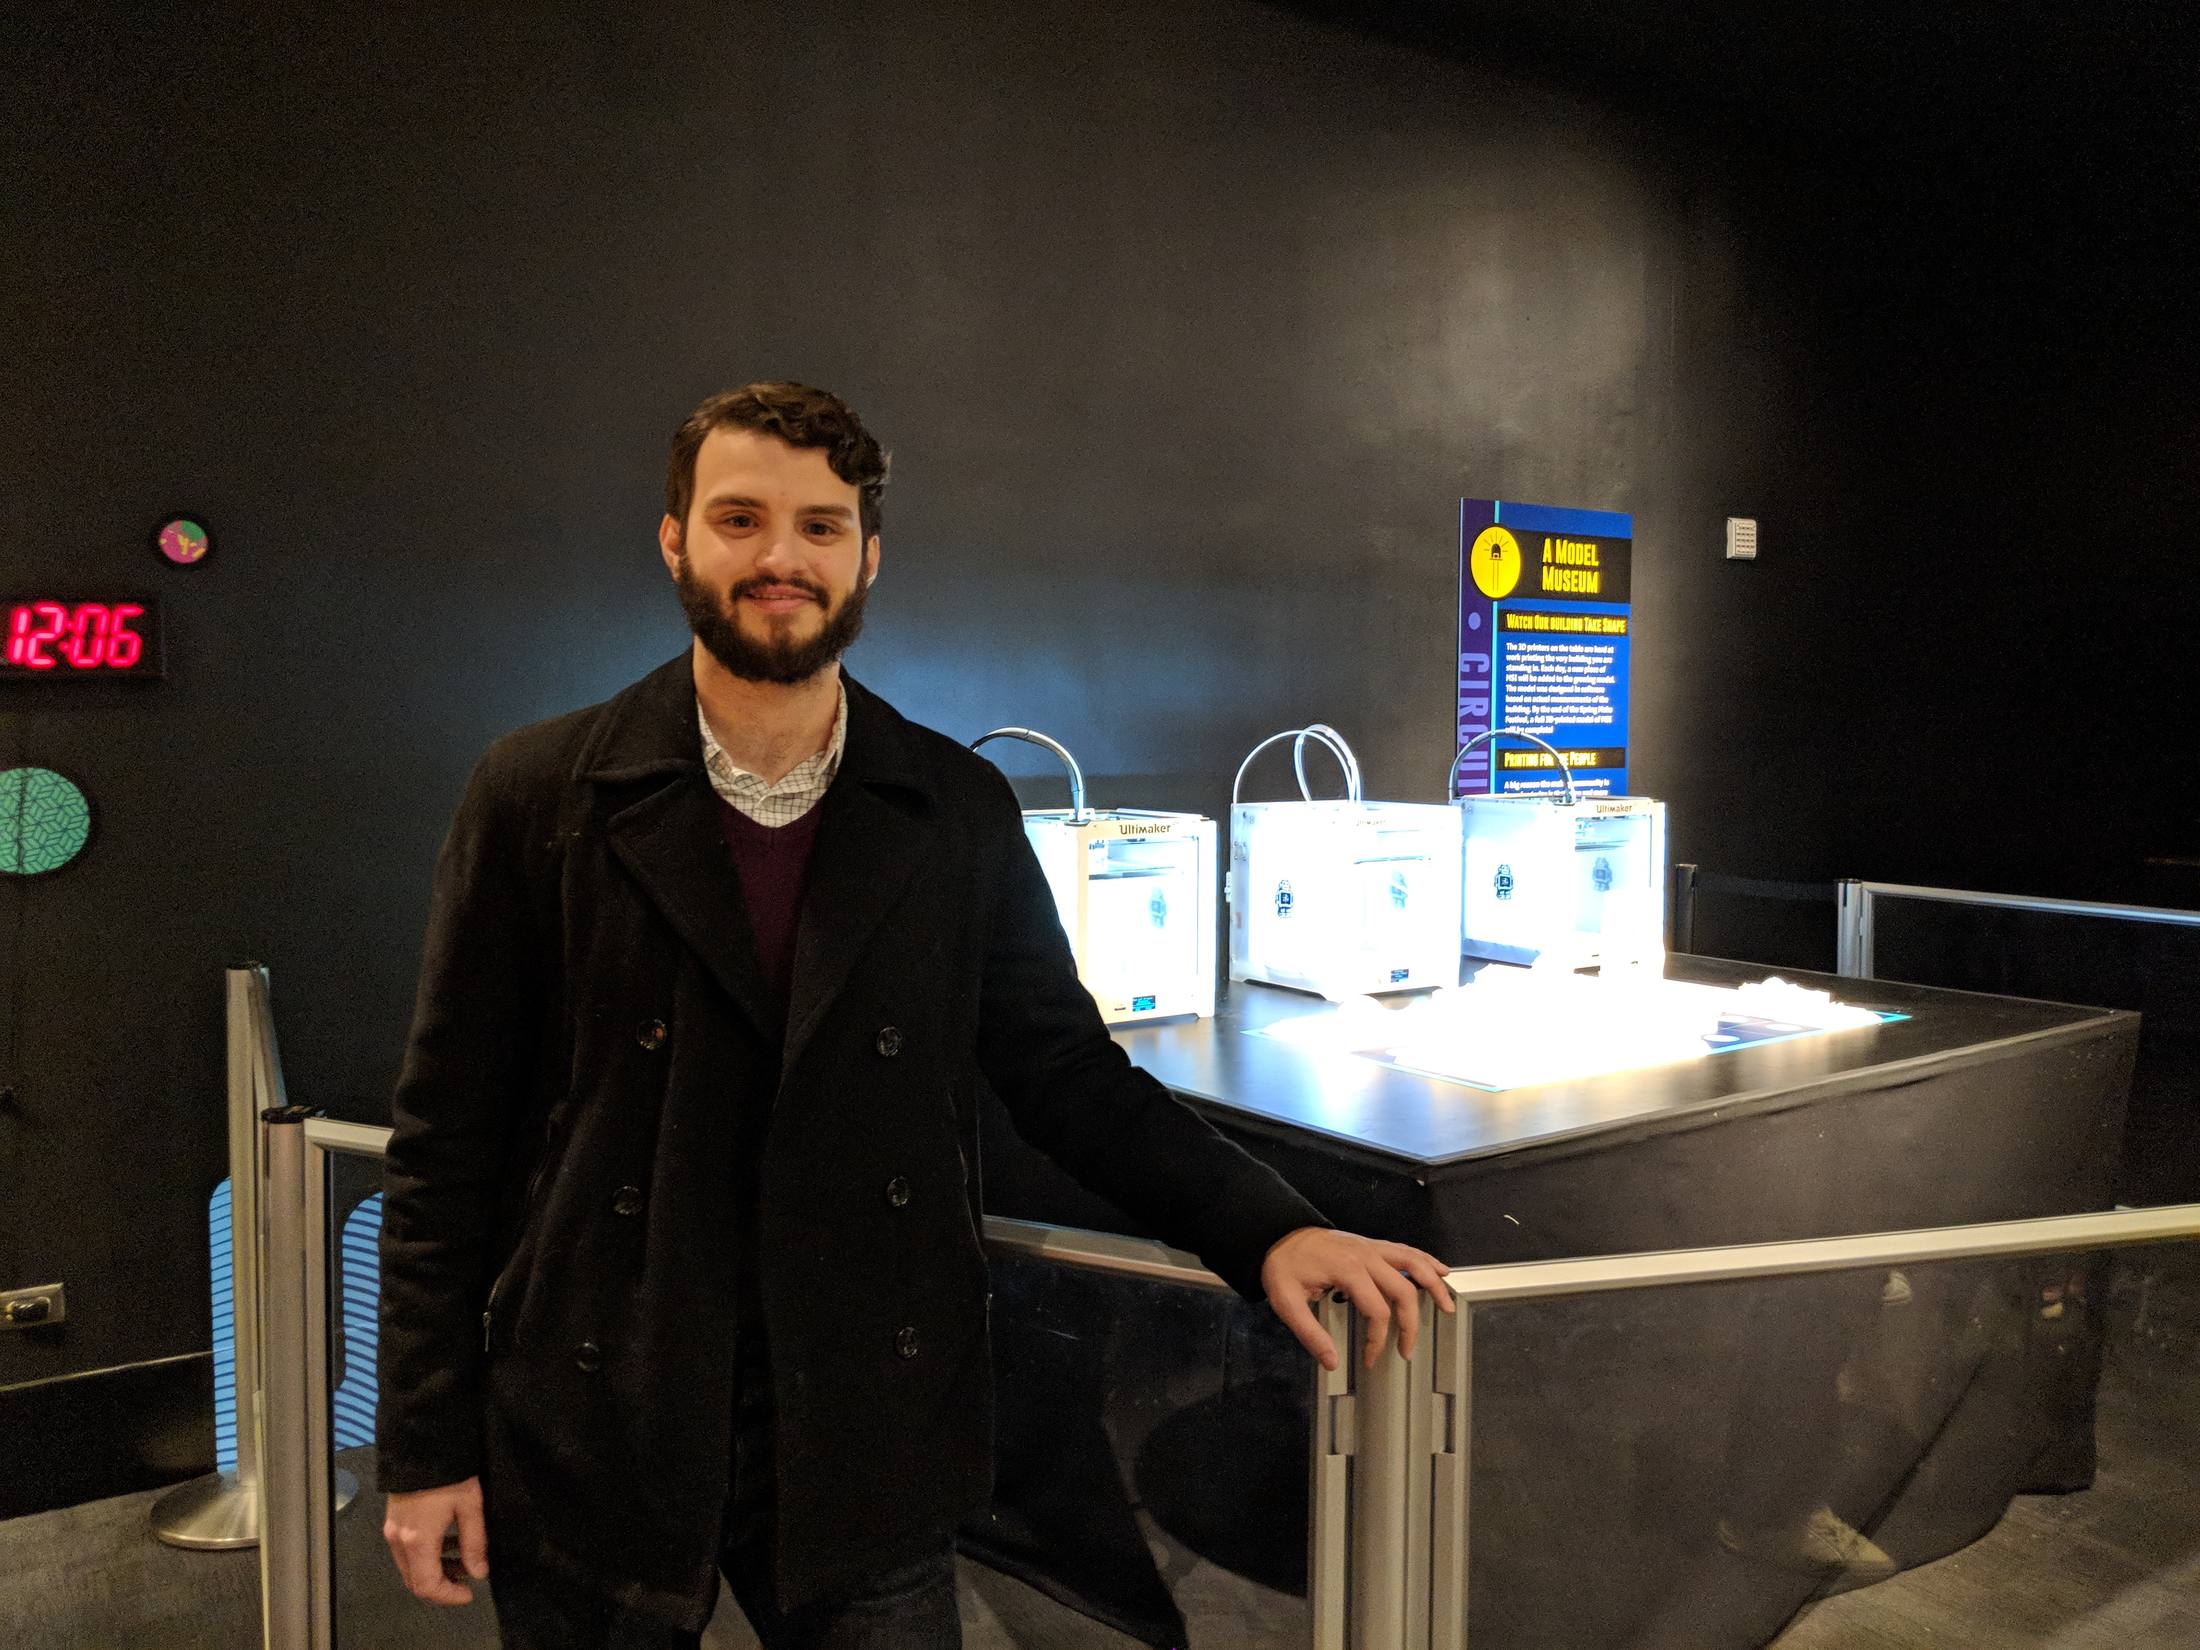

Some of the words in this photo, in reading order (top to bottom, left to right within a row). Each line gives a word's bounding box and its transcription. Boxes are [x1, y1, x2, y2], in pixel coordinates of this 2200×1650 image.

[1542, 537, 1553, 564] A
[1555, 538, 1600, 568] MODEL
[1542, 565, 1600, 594] MUSEUM
[1506, 613, 1534, 630] WATCH
[1534, 615, 1550, 631] OUR
[1550, 616, 1584, 632] BUILDING
[1584, 616, 1602, 633] TAKE
[1602, 618, 1627, 634] SHAPE
[9, 600, 144, 668] 12:06
[1506, 642, 1518, 651] The
[1518, 643, 1527, 651] 3D
[1569, 751, 1598, 767] PEOPLE
[1596, 804, 1633, 814] Ultimaker
[1119, 823, 1171, 835] Ultimaker
